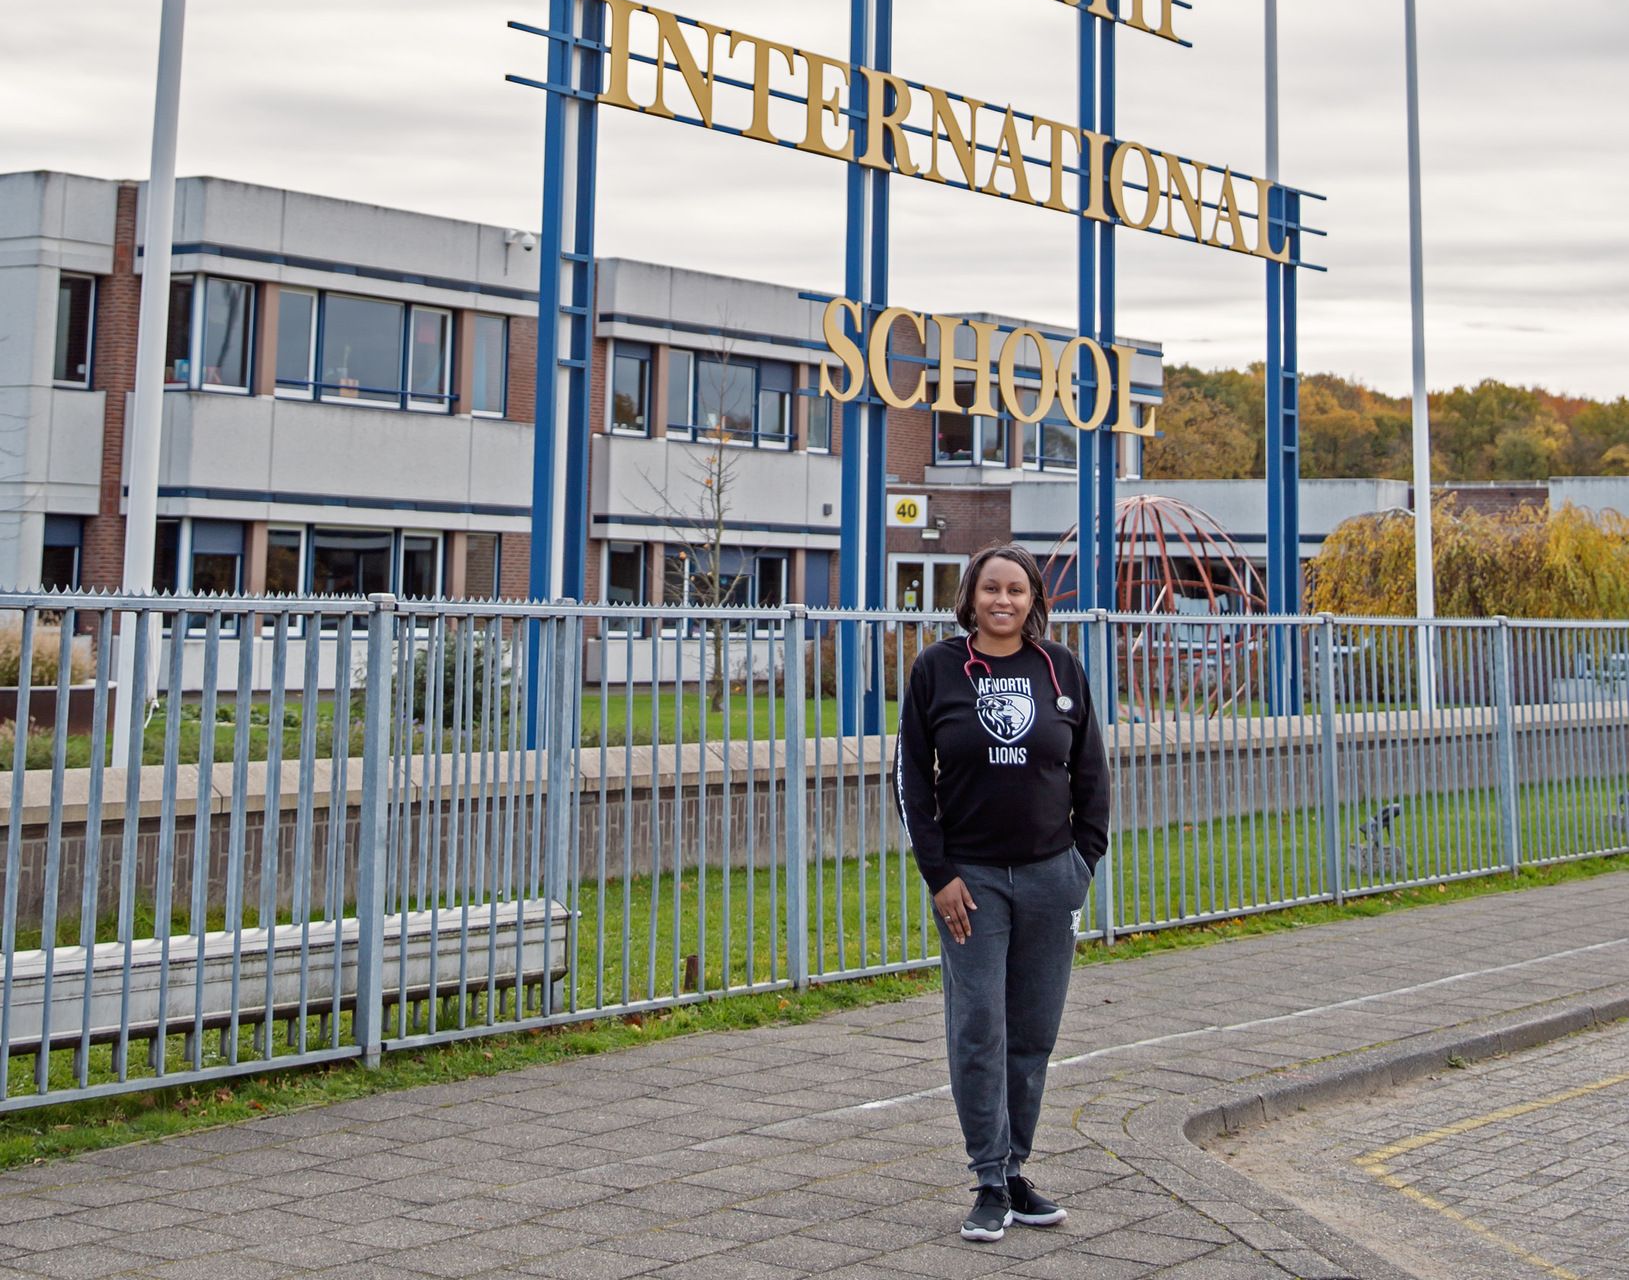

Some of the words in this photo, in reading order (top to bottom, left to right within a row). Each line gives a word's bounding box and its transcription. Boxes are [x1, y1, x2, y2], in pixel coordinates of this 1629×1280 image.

[819, 297, 1155, 436] SCHOOL
[896, 503, 918, 519] 40
[978, 677, 1032, 697] AFNORTH
[988, 746, 1027, 764] LIONS
